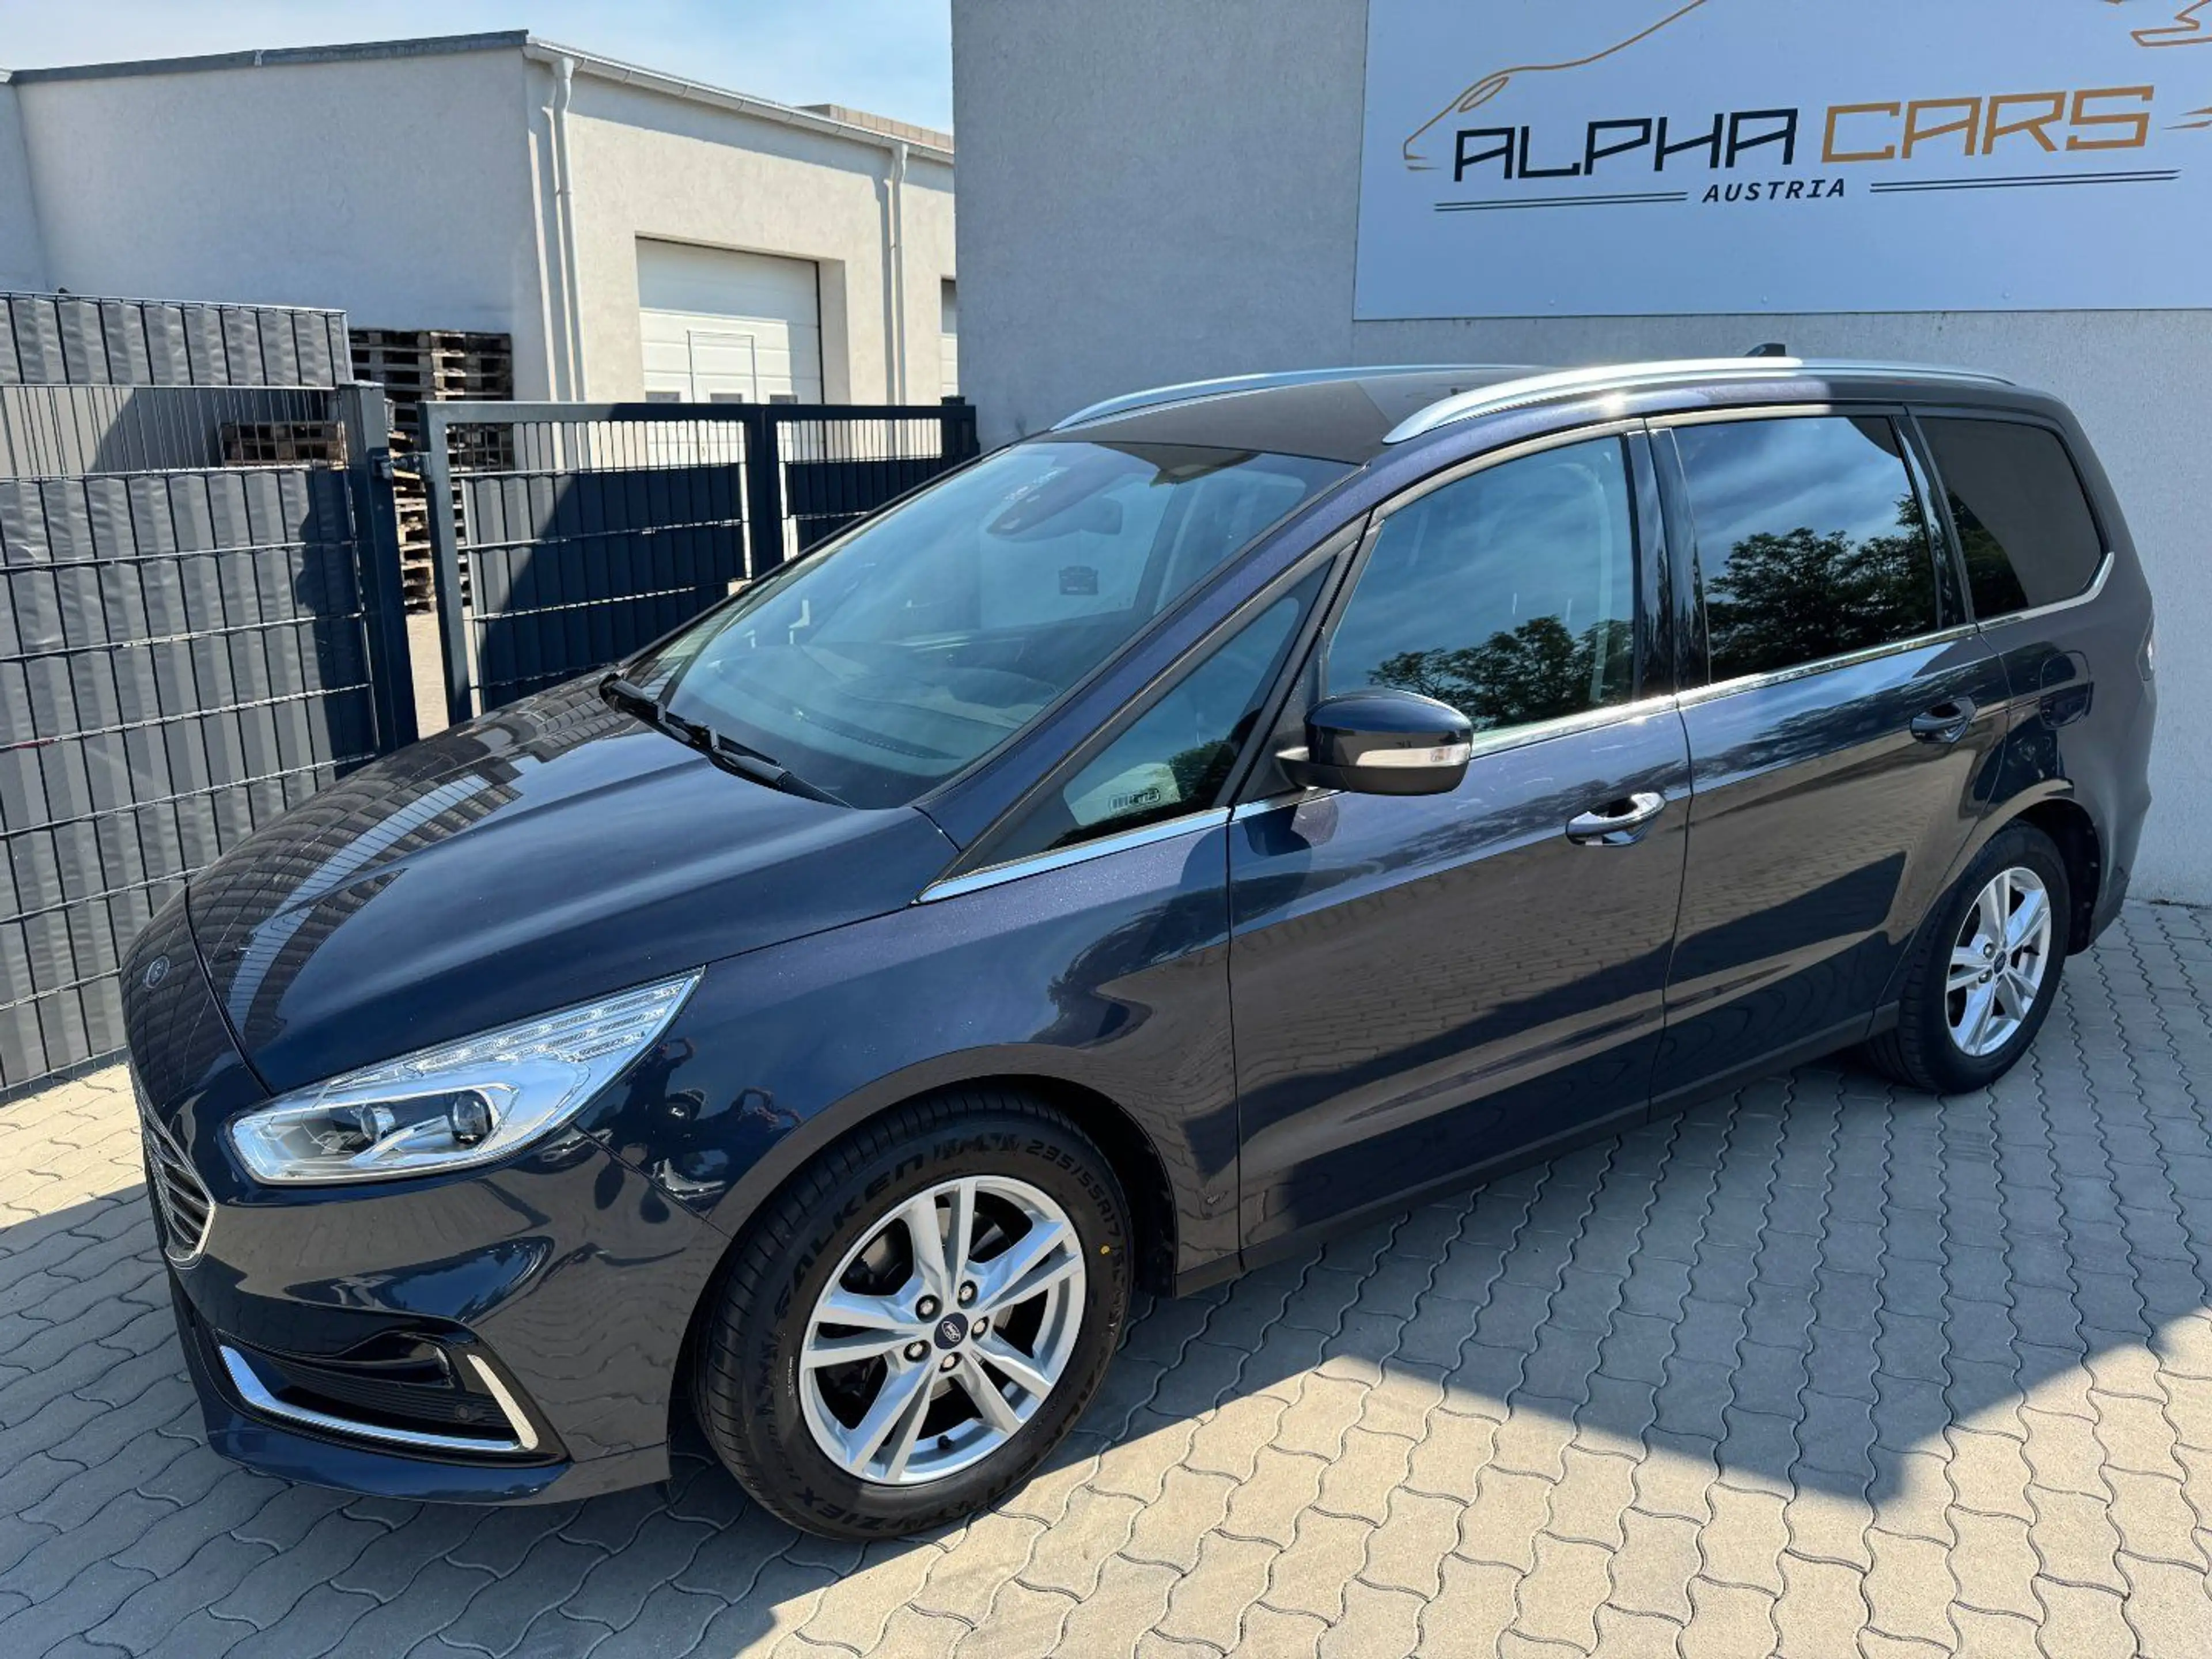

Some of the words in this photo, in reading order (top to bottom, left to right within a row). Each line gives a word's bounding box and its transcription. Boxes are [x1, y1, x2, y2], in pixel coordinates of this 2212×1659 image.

[1454, 108, 1798, 181] ALPHA
[1821, 85, 2154, 164] CARS
[1702, 178, 1844, 203] AUSTRIA
[1025, 1139, 1121, 1237] 235/55R17
[795, 1486, 890, 1531] ZIEX
